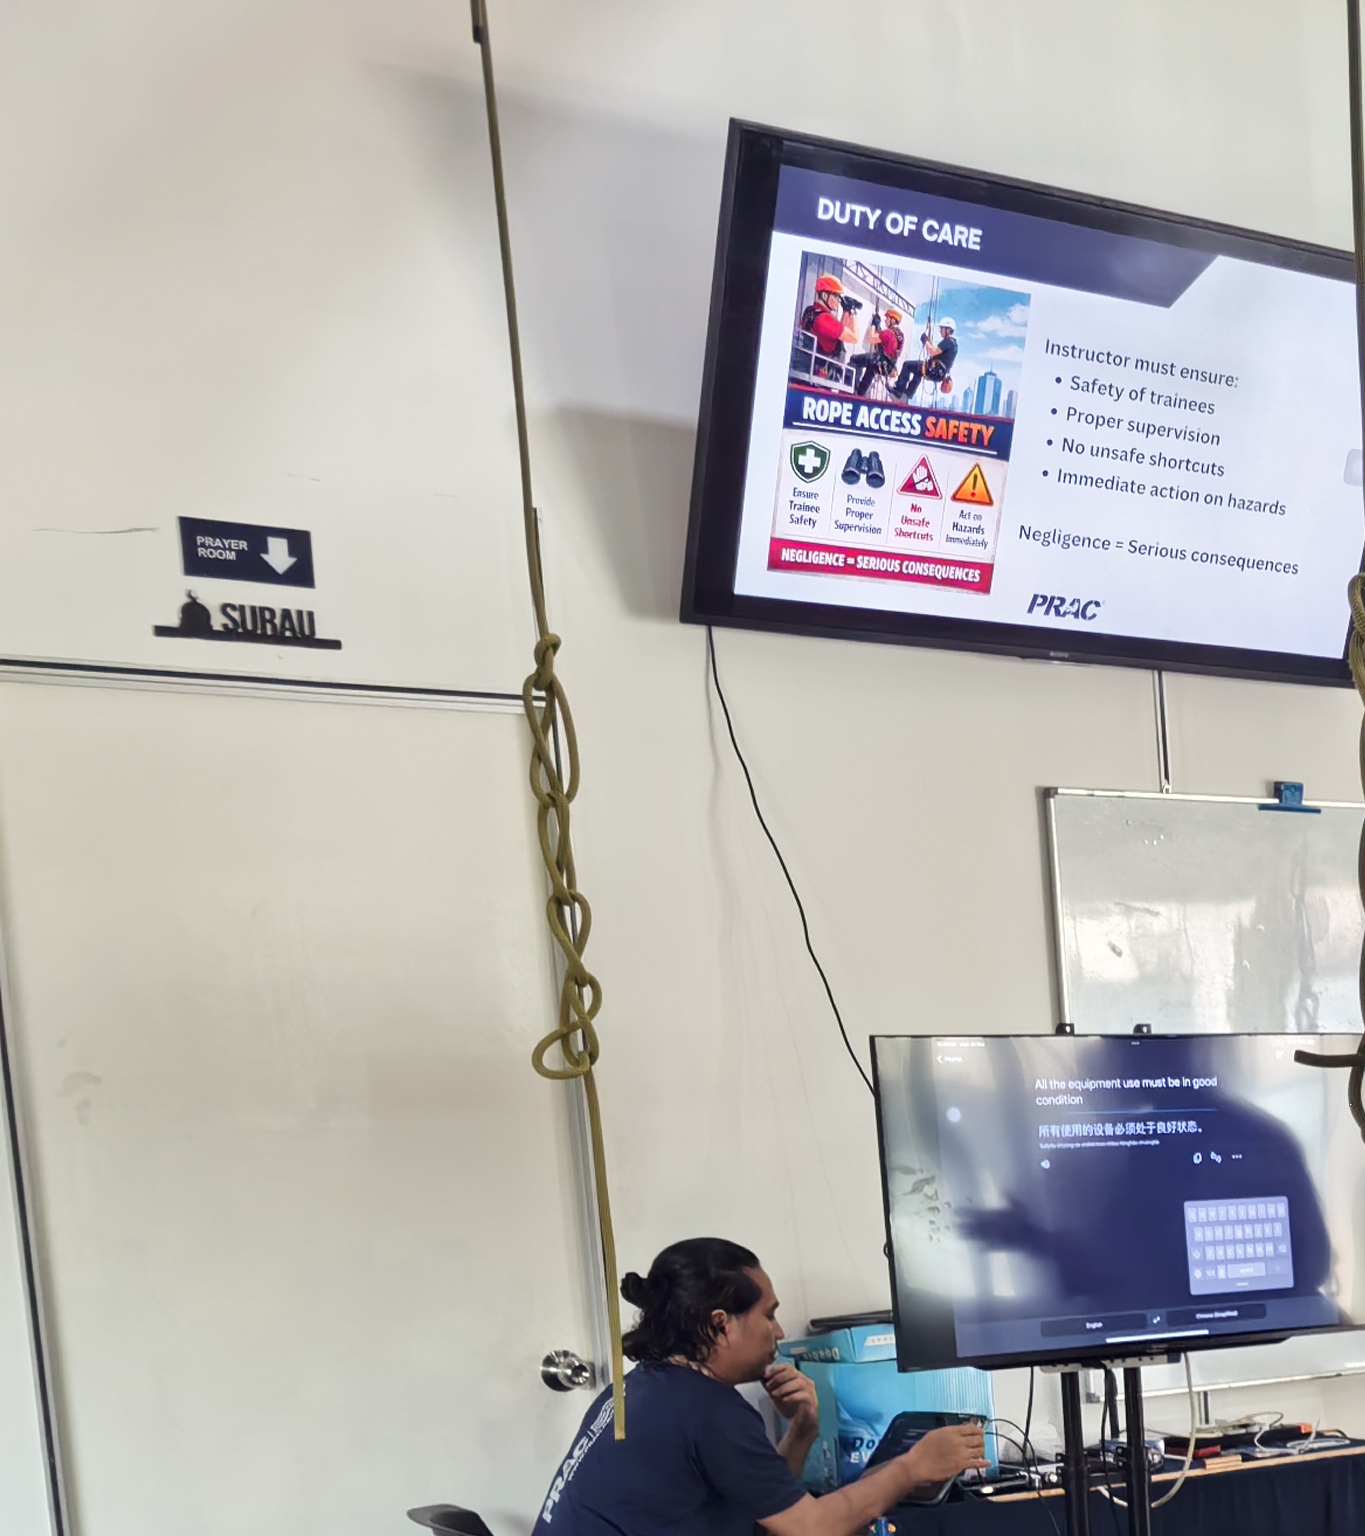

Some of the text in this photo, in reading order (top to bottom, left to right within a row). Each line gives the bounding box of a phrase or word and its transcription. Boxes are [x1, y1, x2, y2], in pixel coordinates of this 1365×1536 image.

[816, 197, 983, 252] DUTY OF CARE
[1045, 338, 1239, 389] Instructor must ensure:
[1070, 375, 1216, 415] Safety of trainees
[802, 396, 995, 447] ROPE ACCESS SAFETY
[1066, 406, 1221, 446] Proper supervision
[1061, 437, 1226, 478] No unsafe shortcuts
[792, 487, 820, 500] Ensure
[1057, 468, 1288, 517] Immediate action on hazards
[788, 500, 821, 514] Trainee
[846, 494, 876, 508] Provide
[910, 503, 923, 514] No
[789, 513, 818, 529] Safety
[845, 507, 874, 521] Proper
[900, 515, 931, 529] Unsafe
[834, 519, 882, 536] Supervision
[894, 527, 934, 542] Shortcuts
[951, 521, 986, 536] Hazards
[196, 535, 249, 551] PRAYER
[1018, 524, 1112, 550] Negligence
[1127, 539, 1187, 560] Serious
[1190, 548, 1299, 575] consequences
[198, 547, 236, 561] ROOM
[781, 547, 845, 568] NEGLIGENCE
[856, 555, 901, 573] SERIOUS
[902, 561, 981, 583] CONSEQUENCES
[1026, 593, 1102, 621] PRAC
[221, 602, 316, 638] SURAU
[1035, 1076, 1218, 1091] All the equipment use must be in good
[1036, 1094, 1084, 1106] condition
[542, 1436, 589, 1523] PRAC
